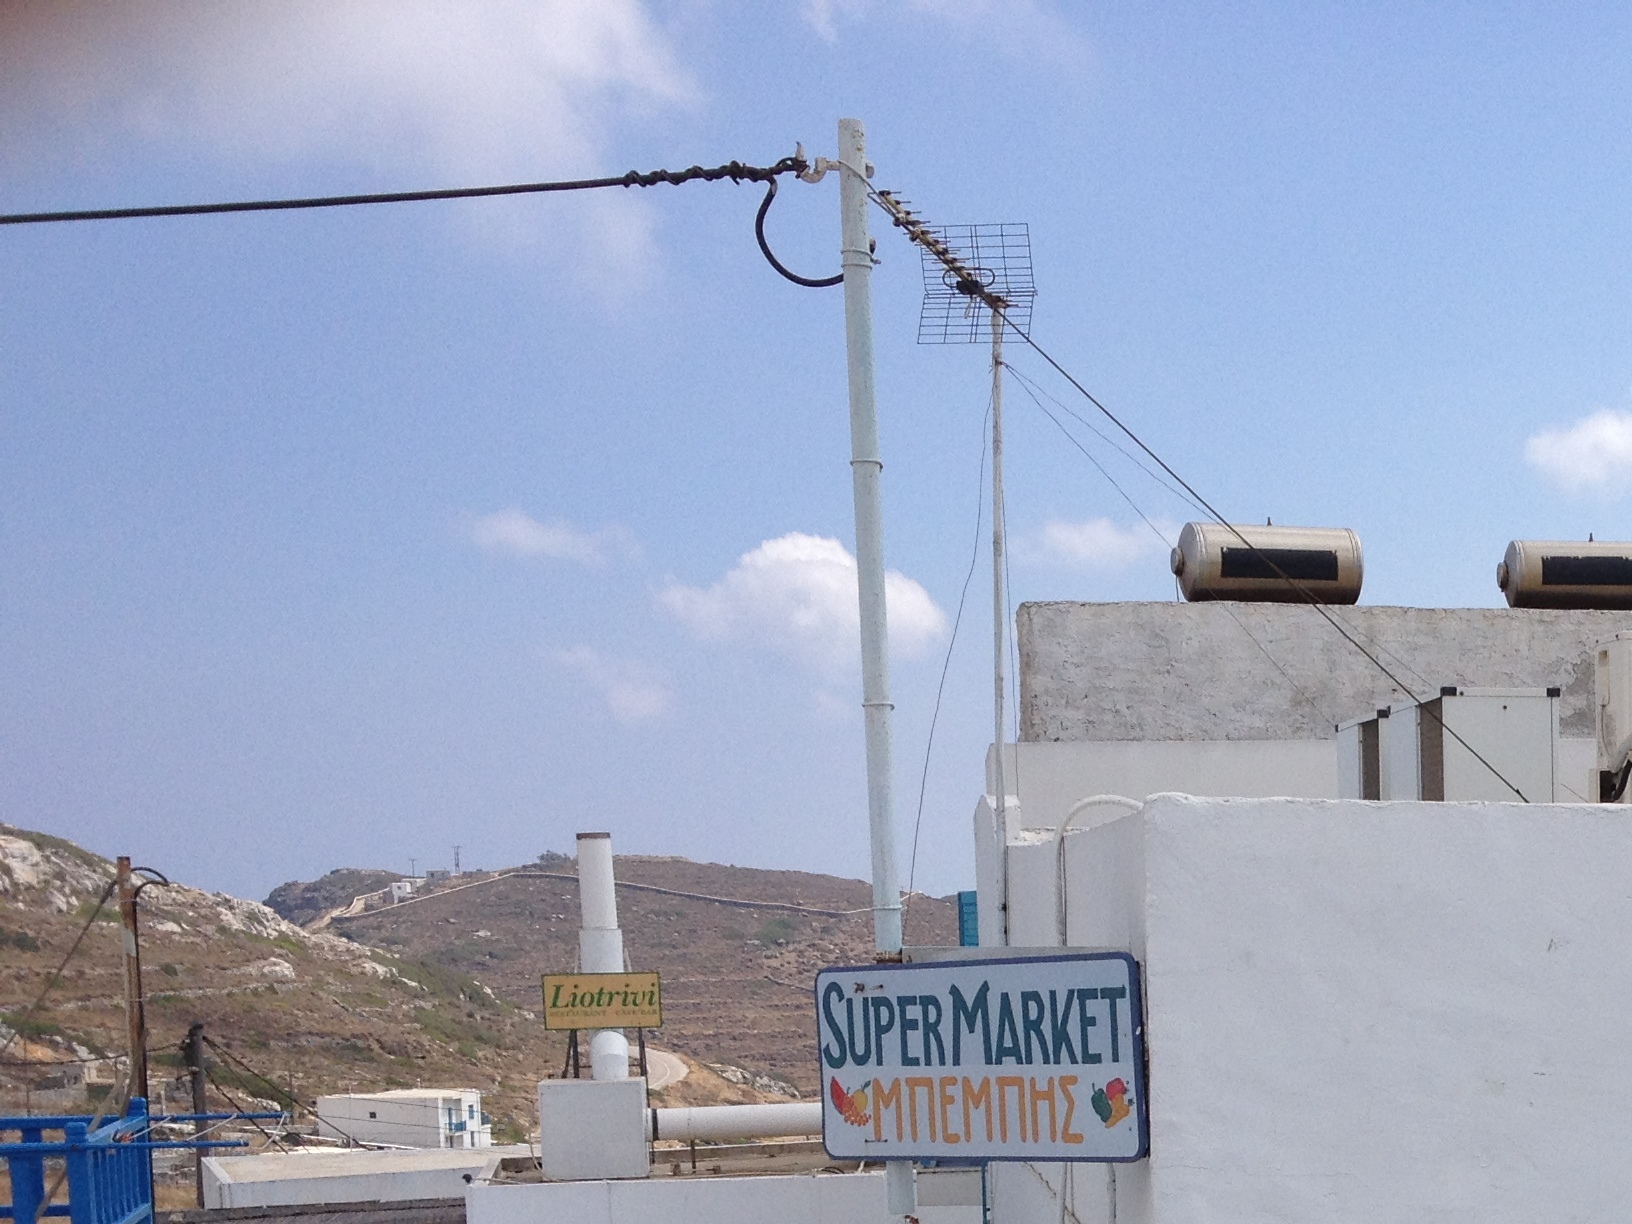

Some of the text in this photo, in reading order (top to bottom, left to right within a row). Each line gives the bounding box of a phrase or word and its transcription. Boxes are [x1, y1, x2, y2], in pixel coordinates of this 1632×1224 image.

[550, 982, 656, 1009] Liotrivi
[822, 980, 1127, 1069] SUPER MARKET
[872, 1075, 1084, 1144] ΜΠΕΜΠΗΣ
